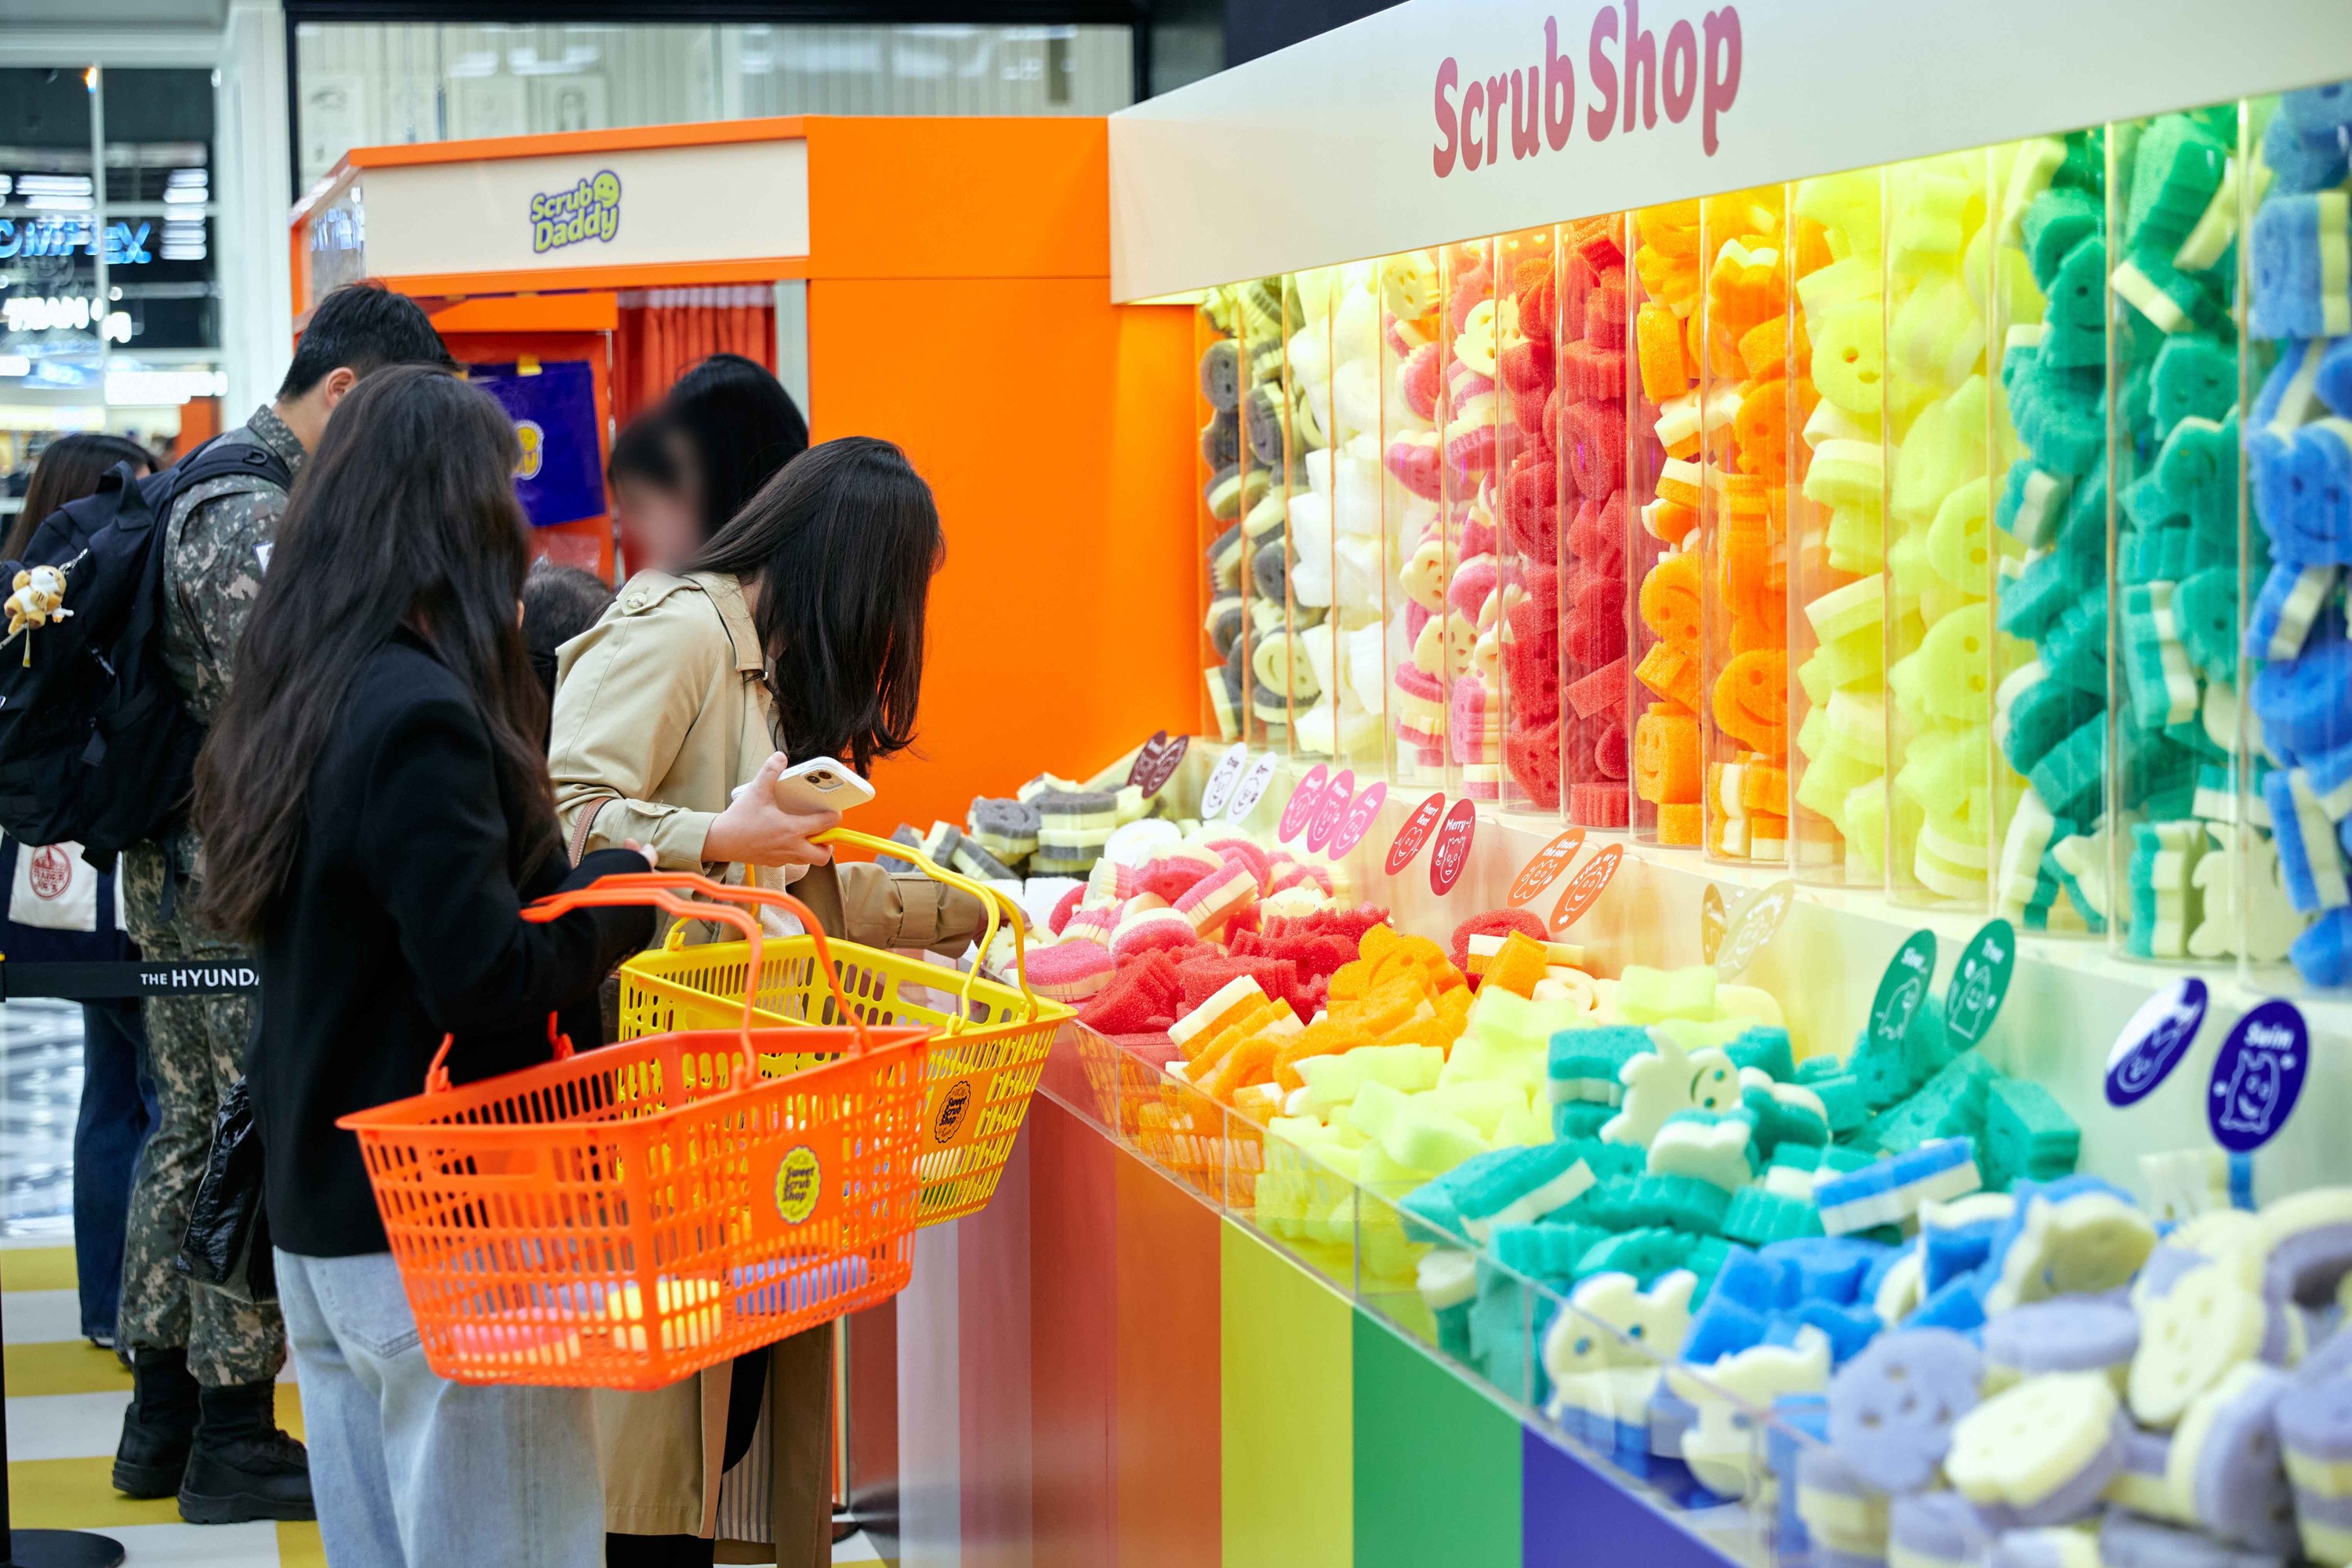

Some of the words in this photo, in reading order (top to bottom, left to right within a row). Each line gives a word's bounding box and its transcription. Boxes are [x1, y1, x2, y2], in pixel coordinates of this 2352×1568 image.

[1433, 16, 1575, 178] Scrub
[1587, 0, 1742, 157] Shop
[531, 180, 594, 223] Scrub
[534, 202, 619, 252] Daddy
[1422, 803, 1439, 816] Heart
[1417, 813, 1431, 826] Beat
[1556, 839, 1579, 850] Under
[1552, 849, 1568, 858] sea
[1572, 856, 1602, 886] Trick
[140, 973, 168, 985] THE
[947, 1095, 967, 1106] Sweet
[944, 1103, 961, 1116] Scrub
[939, 1115, 956, 1127] Shop
[786, 1165, 815, 1178] Sweet
[785, 1178, 811, 1192] Scrub
[782, 1189, 806, 1203] Shop
